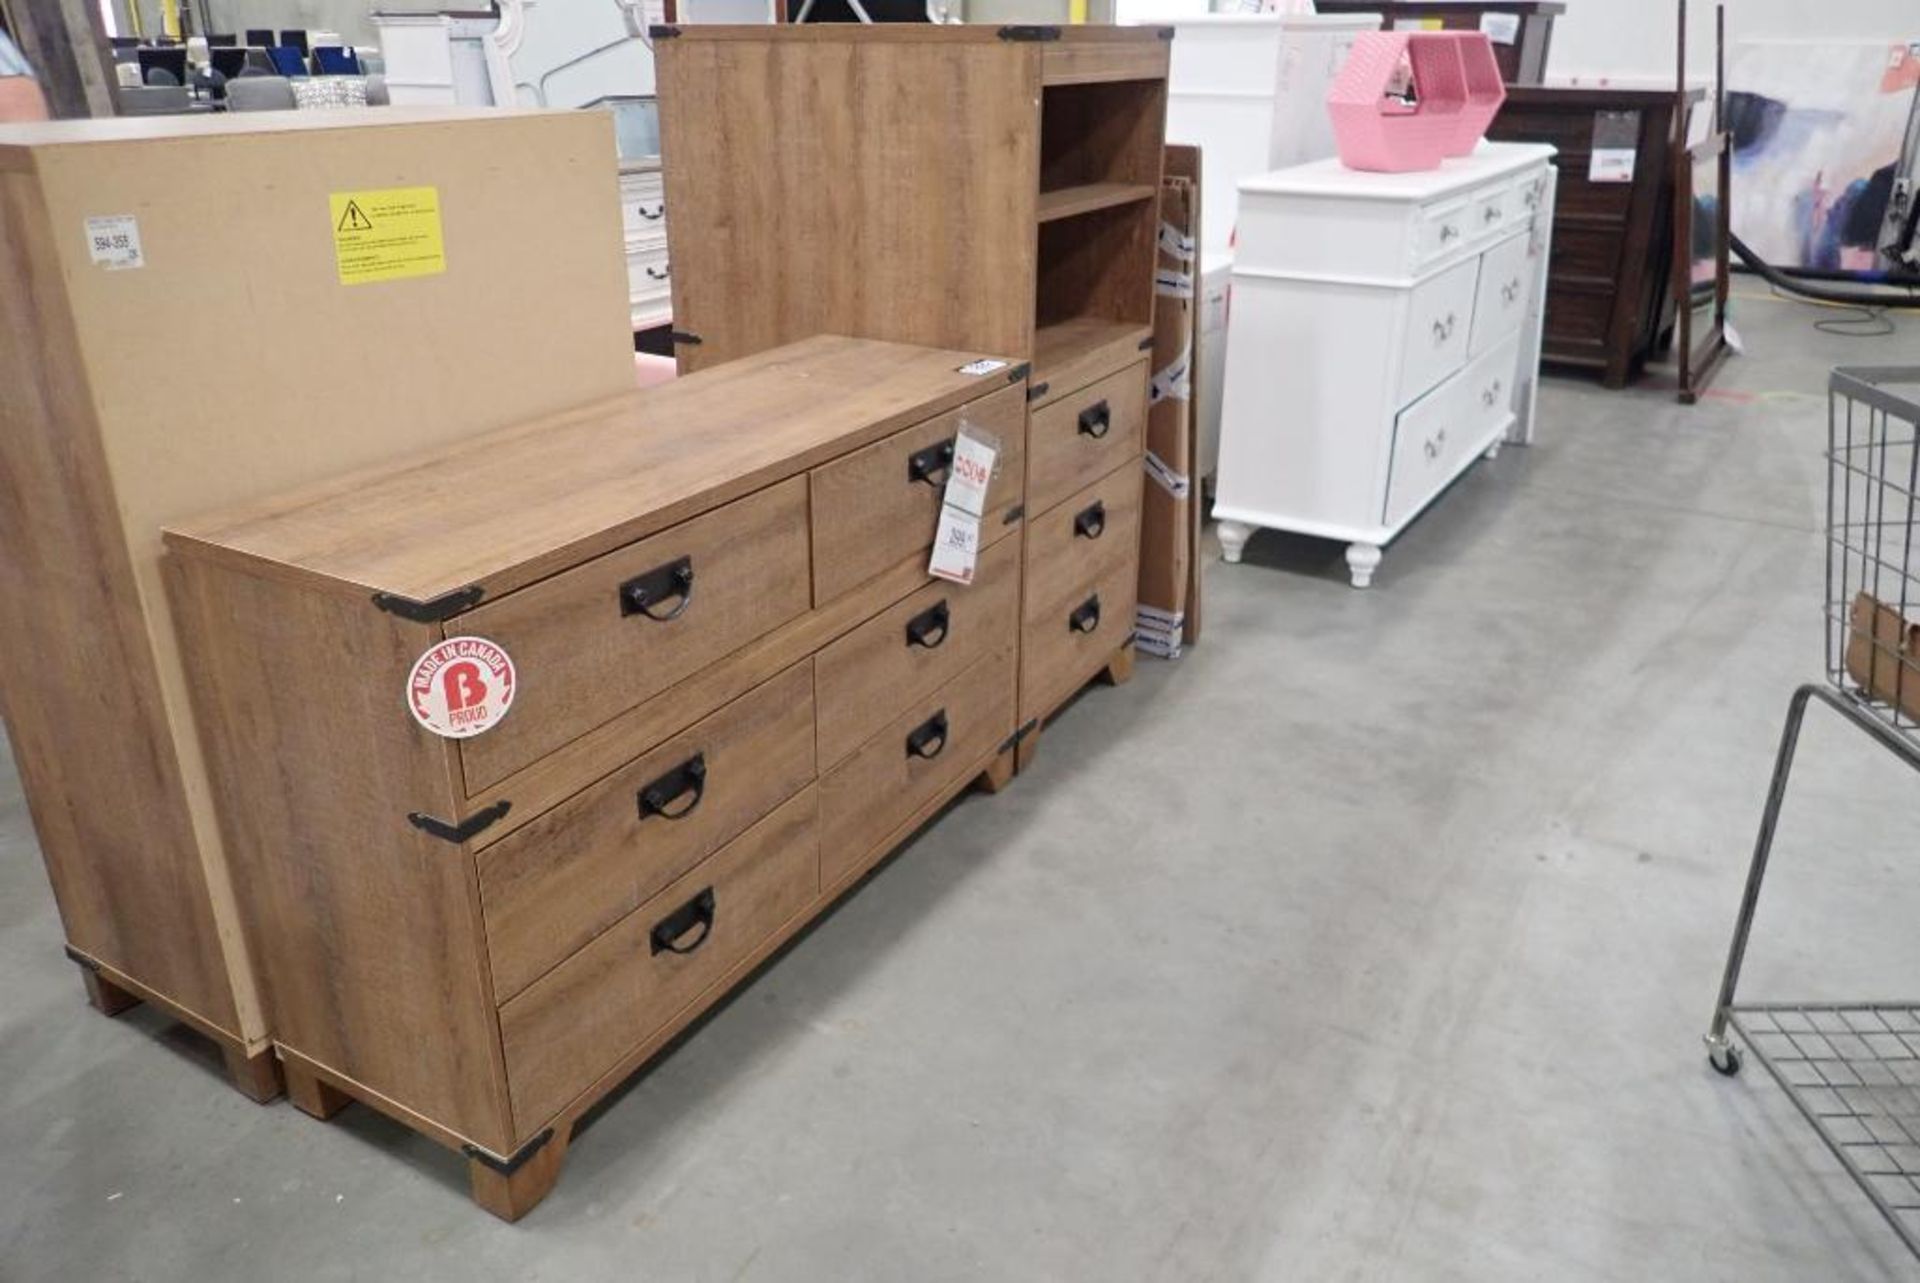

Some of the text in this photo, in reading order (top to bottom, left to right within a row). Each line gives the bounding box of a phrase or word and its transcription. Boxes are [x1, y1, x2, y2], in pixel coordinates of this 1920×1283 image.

[414, 641, 506, 689] MADE IN CANADA
[448, 706, 488, 728] PROUD
